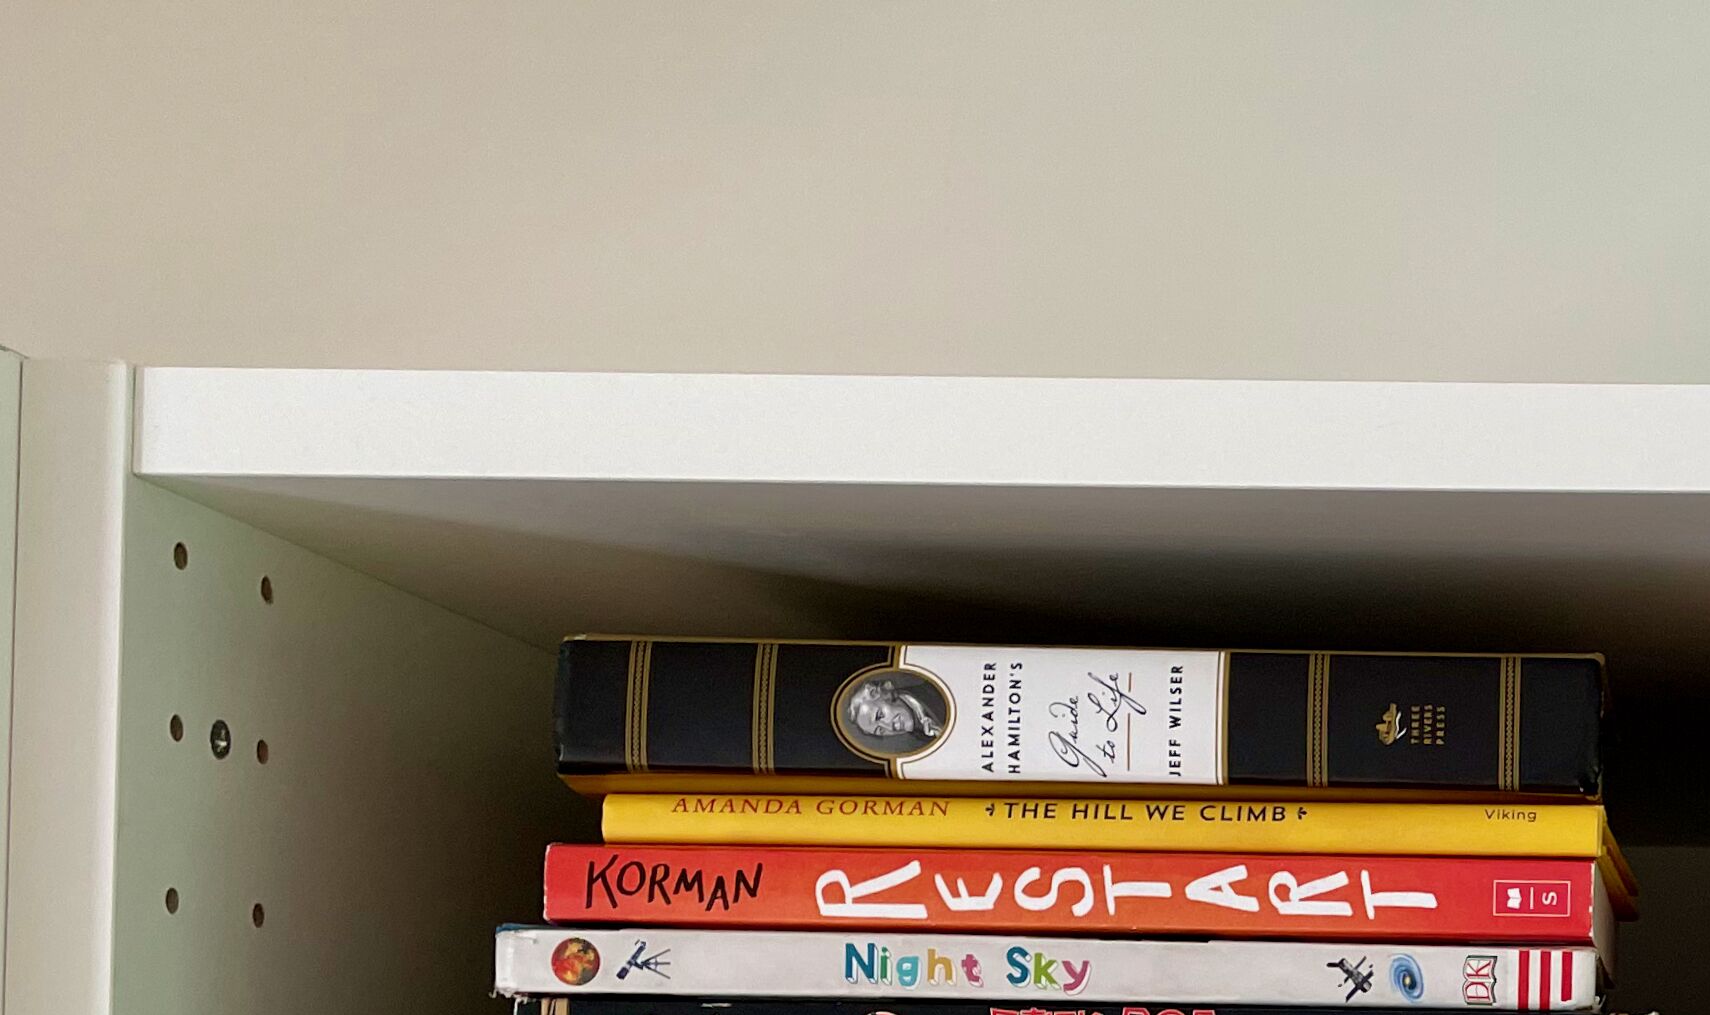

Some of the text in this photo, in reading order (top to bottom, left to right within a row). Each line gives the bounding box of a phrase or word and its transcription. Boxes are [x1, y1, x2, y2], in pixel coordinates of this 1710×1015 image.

[981, 662, 997, 773] ALEXANDER
[1008, 661, 1023, 774] HAMILTON'S
[1049, 695, 1107, 777] Guide
[1087, 671, 1147, 763] to Life
[1169, 665, 1184, 777] JEFF WILSER
[1410, 705, 1420, 745] THREE
[1423, 704, 1433, 745] RIVERS
[1435, 706, 1446, 745] PRESS
[671, 797, 951, 817] AMANDA GORMAN
[1004, 801, 1286, 822] THE HILL WE CLIMB
[1485, 809, 1537, 822] Viking
[585, 854, 763, 912] KORMAN
[814, 859, 1438, 920] RESTART
[1541, 891, 1558, 906] S
[843, 942, 1091, 995] Night Sky
[1465, 960, 1492, 1000] DK
